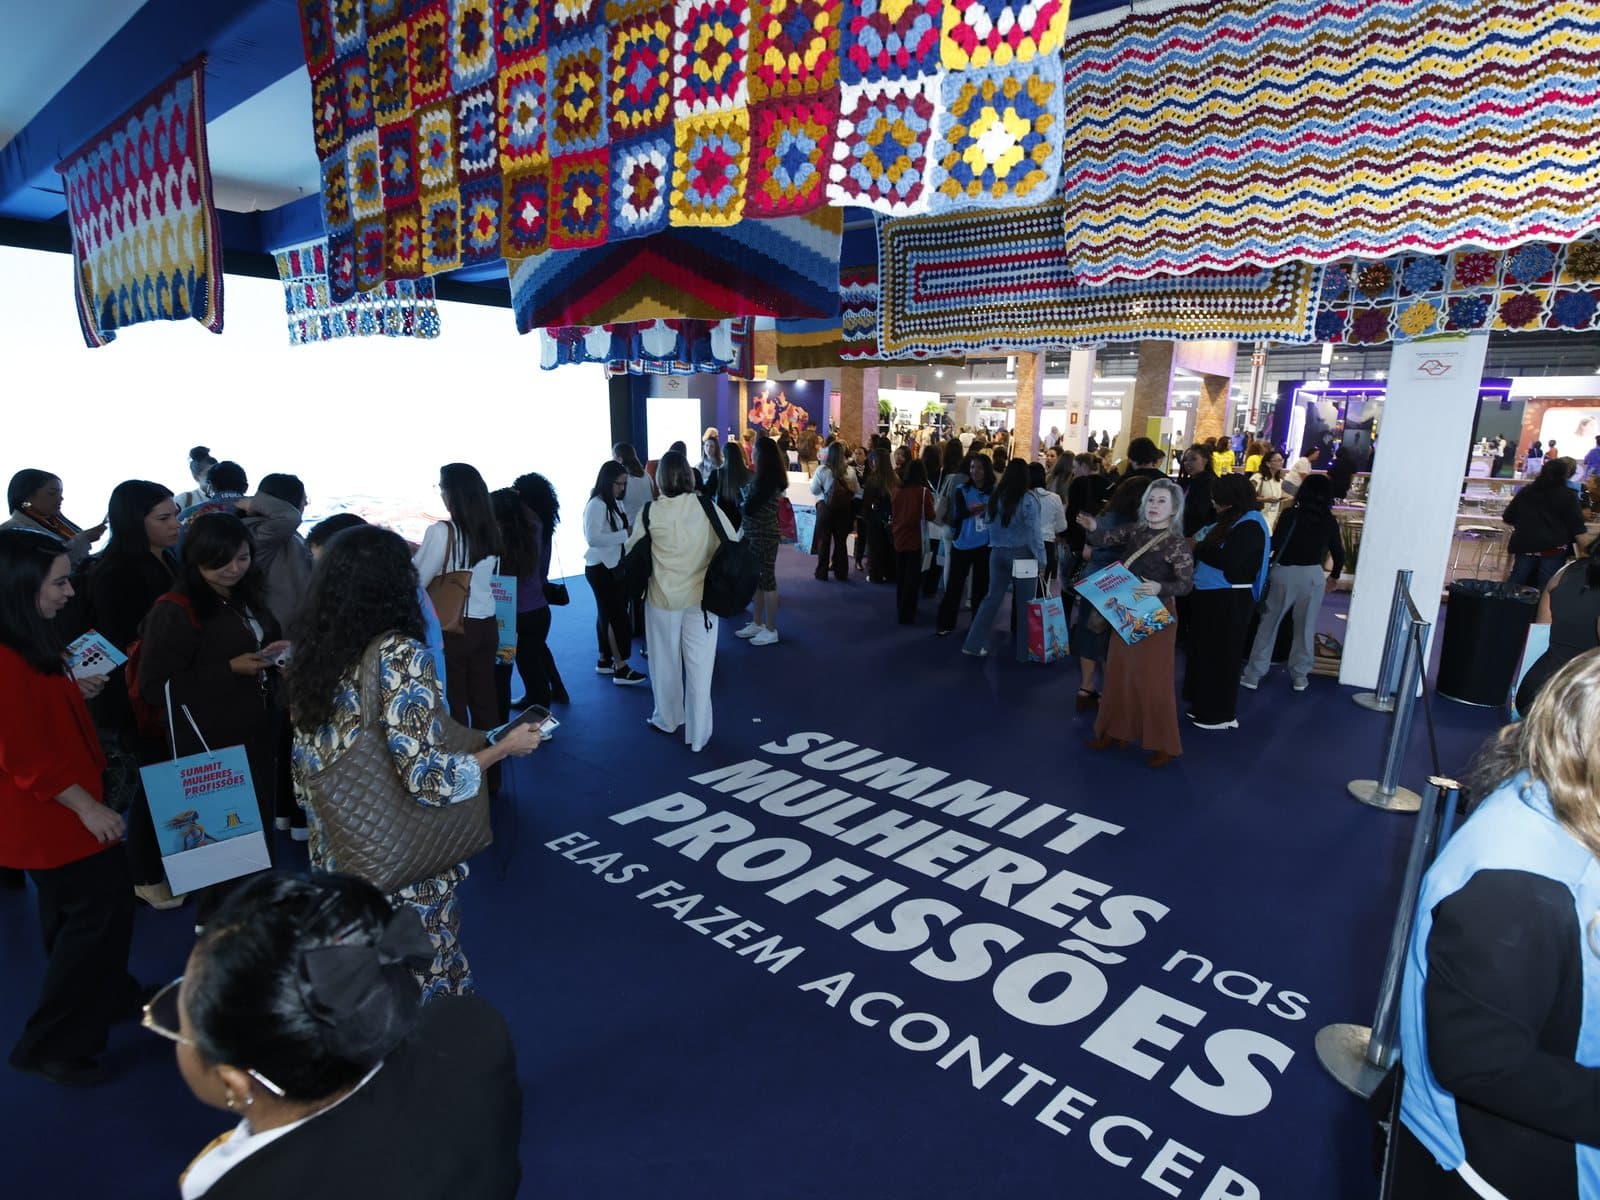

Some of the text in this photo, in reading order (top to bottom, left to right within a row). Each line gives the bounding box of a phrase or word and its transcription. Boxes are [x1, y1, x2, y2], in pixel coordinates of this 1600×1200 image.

[180, 761, 223, 778] SUMMIT
[182, 768, 233, 787] MULHERES
[760, 731, 1125, 854] SUMMIT
[545, 832, 649, 884] ELAS
[637, 880, 806, 974] FAZEM
[609, 791, 1295, 1117] PROFISSÕES
[689, 758, 1311, 1022] MULHERES nas
